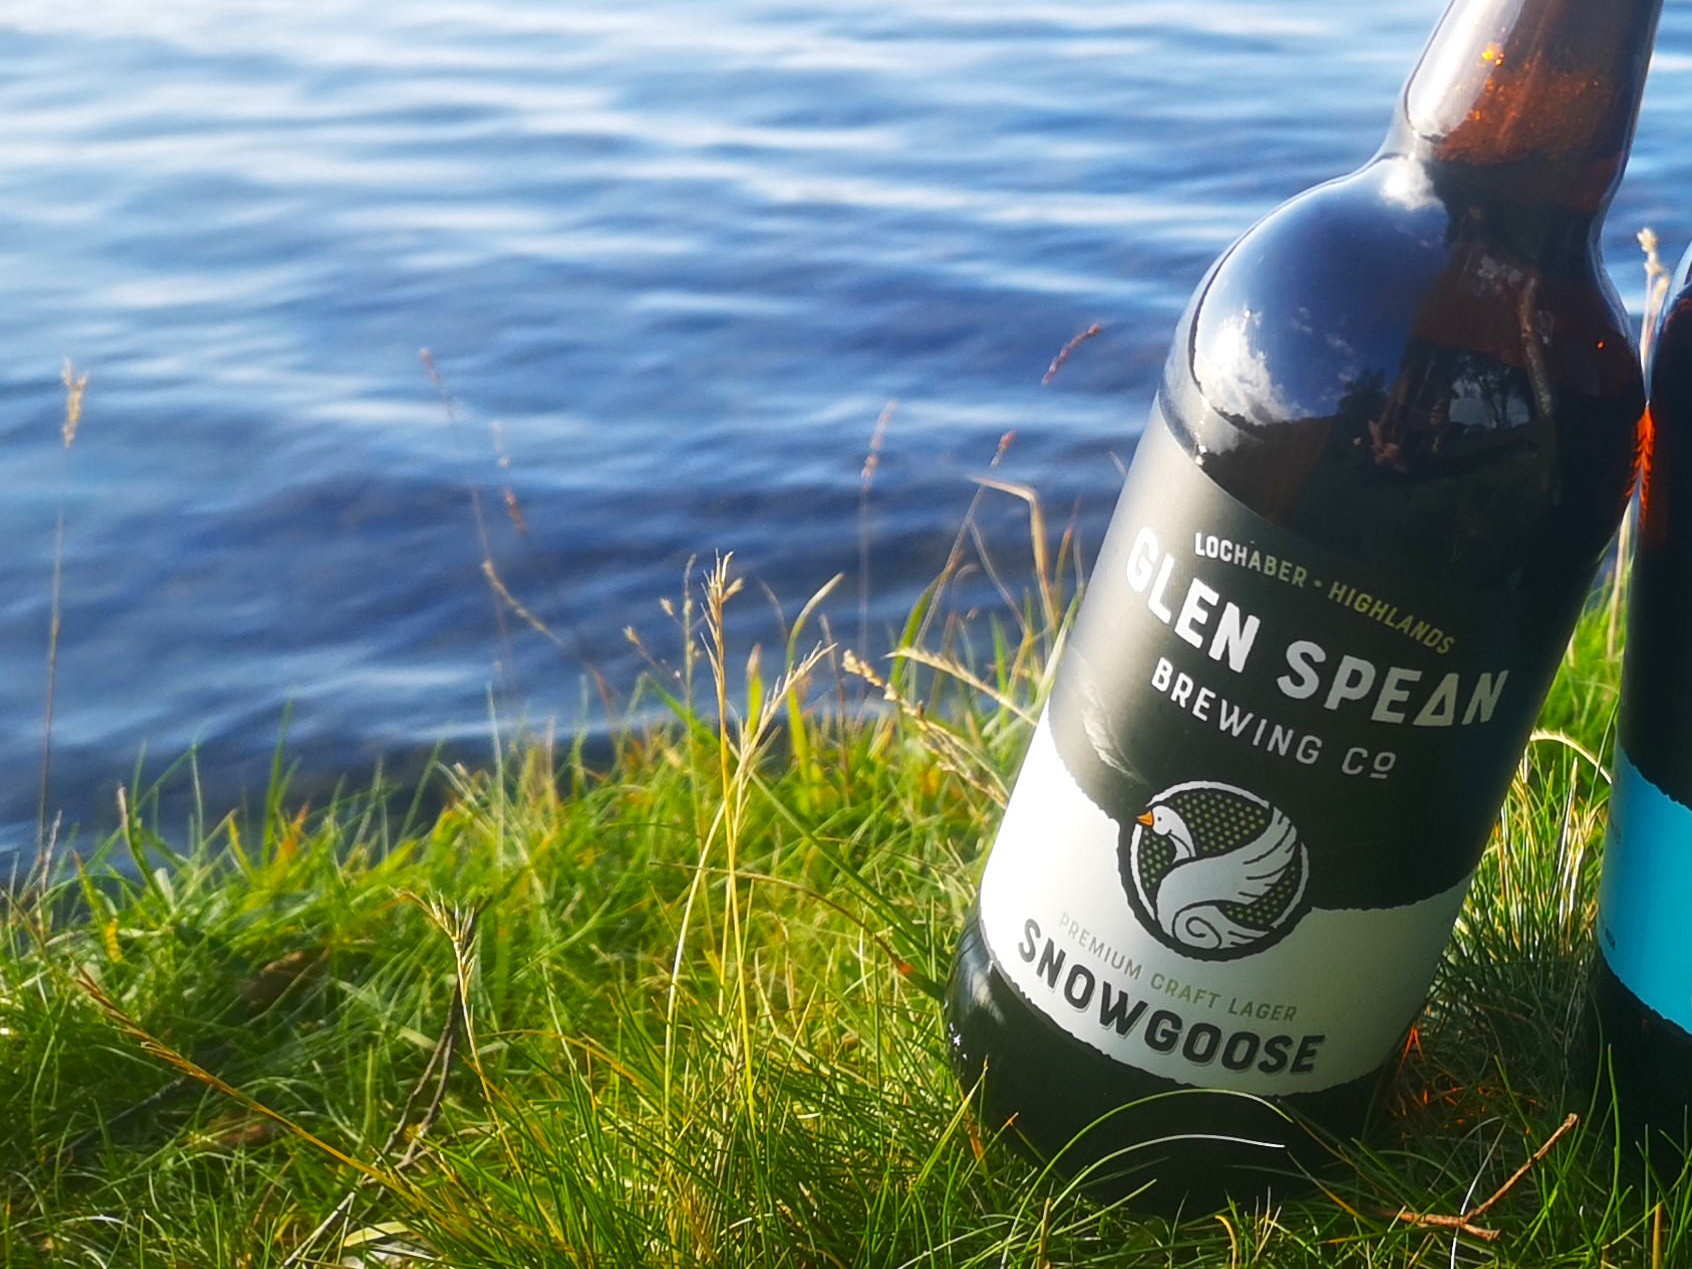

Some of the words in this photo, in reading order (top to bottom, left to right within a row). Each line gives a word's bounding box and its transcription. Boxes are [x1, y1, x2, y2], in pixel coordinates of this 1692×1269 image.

[1126, 527, 1260, 673] GLEN
[1277, 640, 1509, 727] SPEAN
[1195, 532, 1306, 589] LOCHABER
[1328, 582, 1455, 654] HIGHLANDS
[1151, 657, 1320, 766] BREWING
[1018, 918, 1326, 1076] SNOWGOOSE
[1058, 912, 1143, 981] PREMIUM
[1150, 973, 1221, 1009] CRAFT
[1227, 998, 1298, 1023] LAGER
